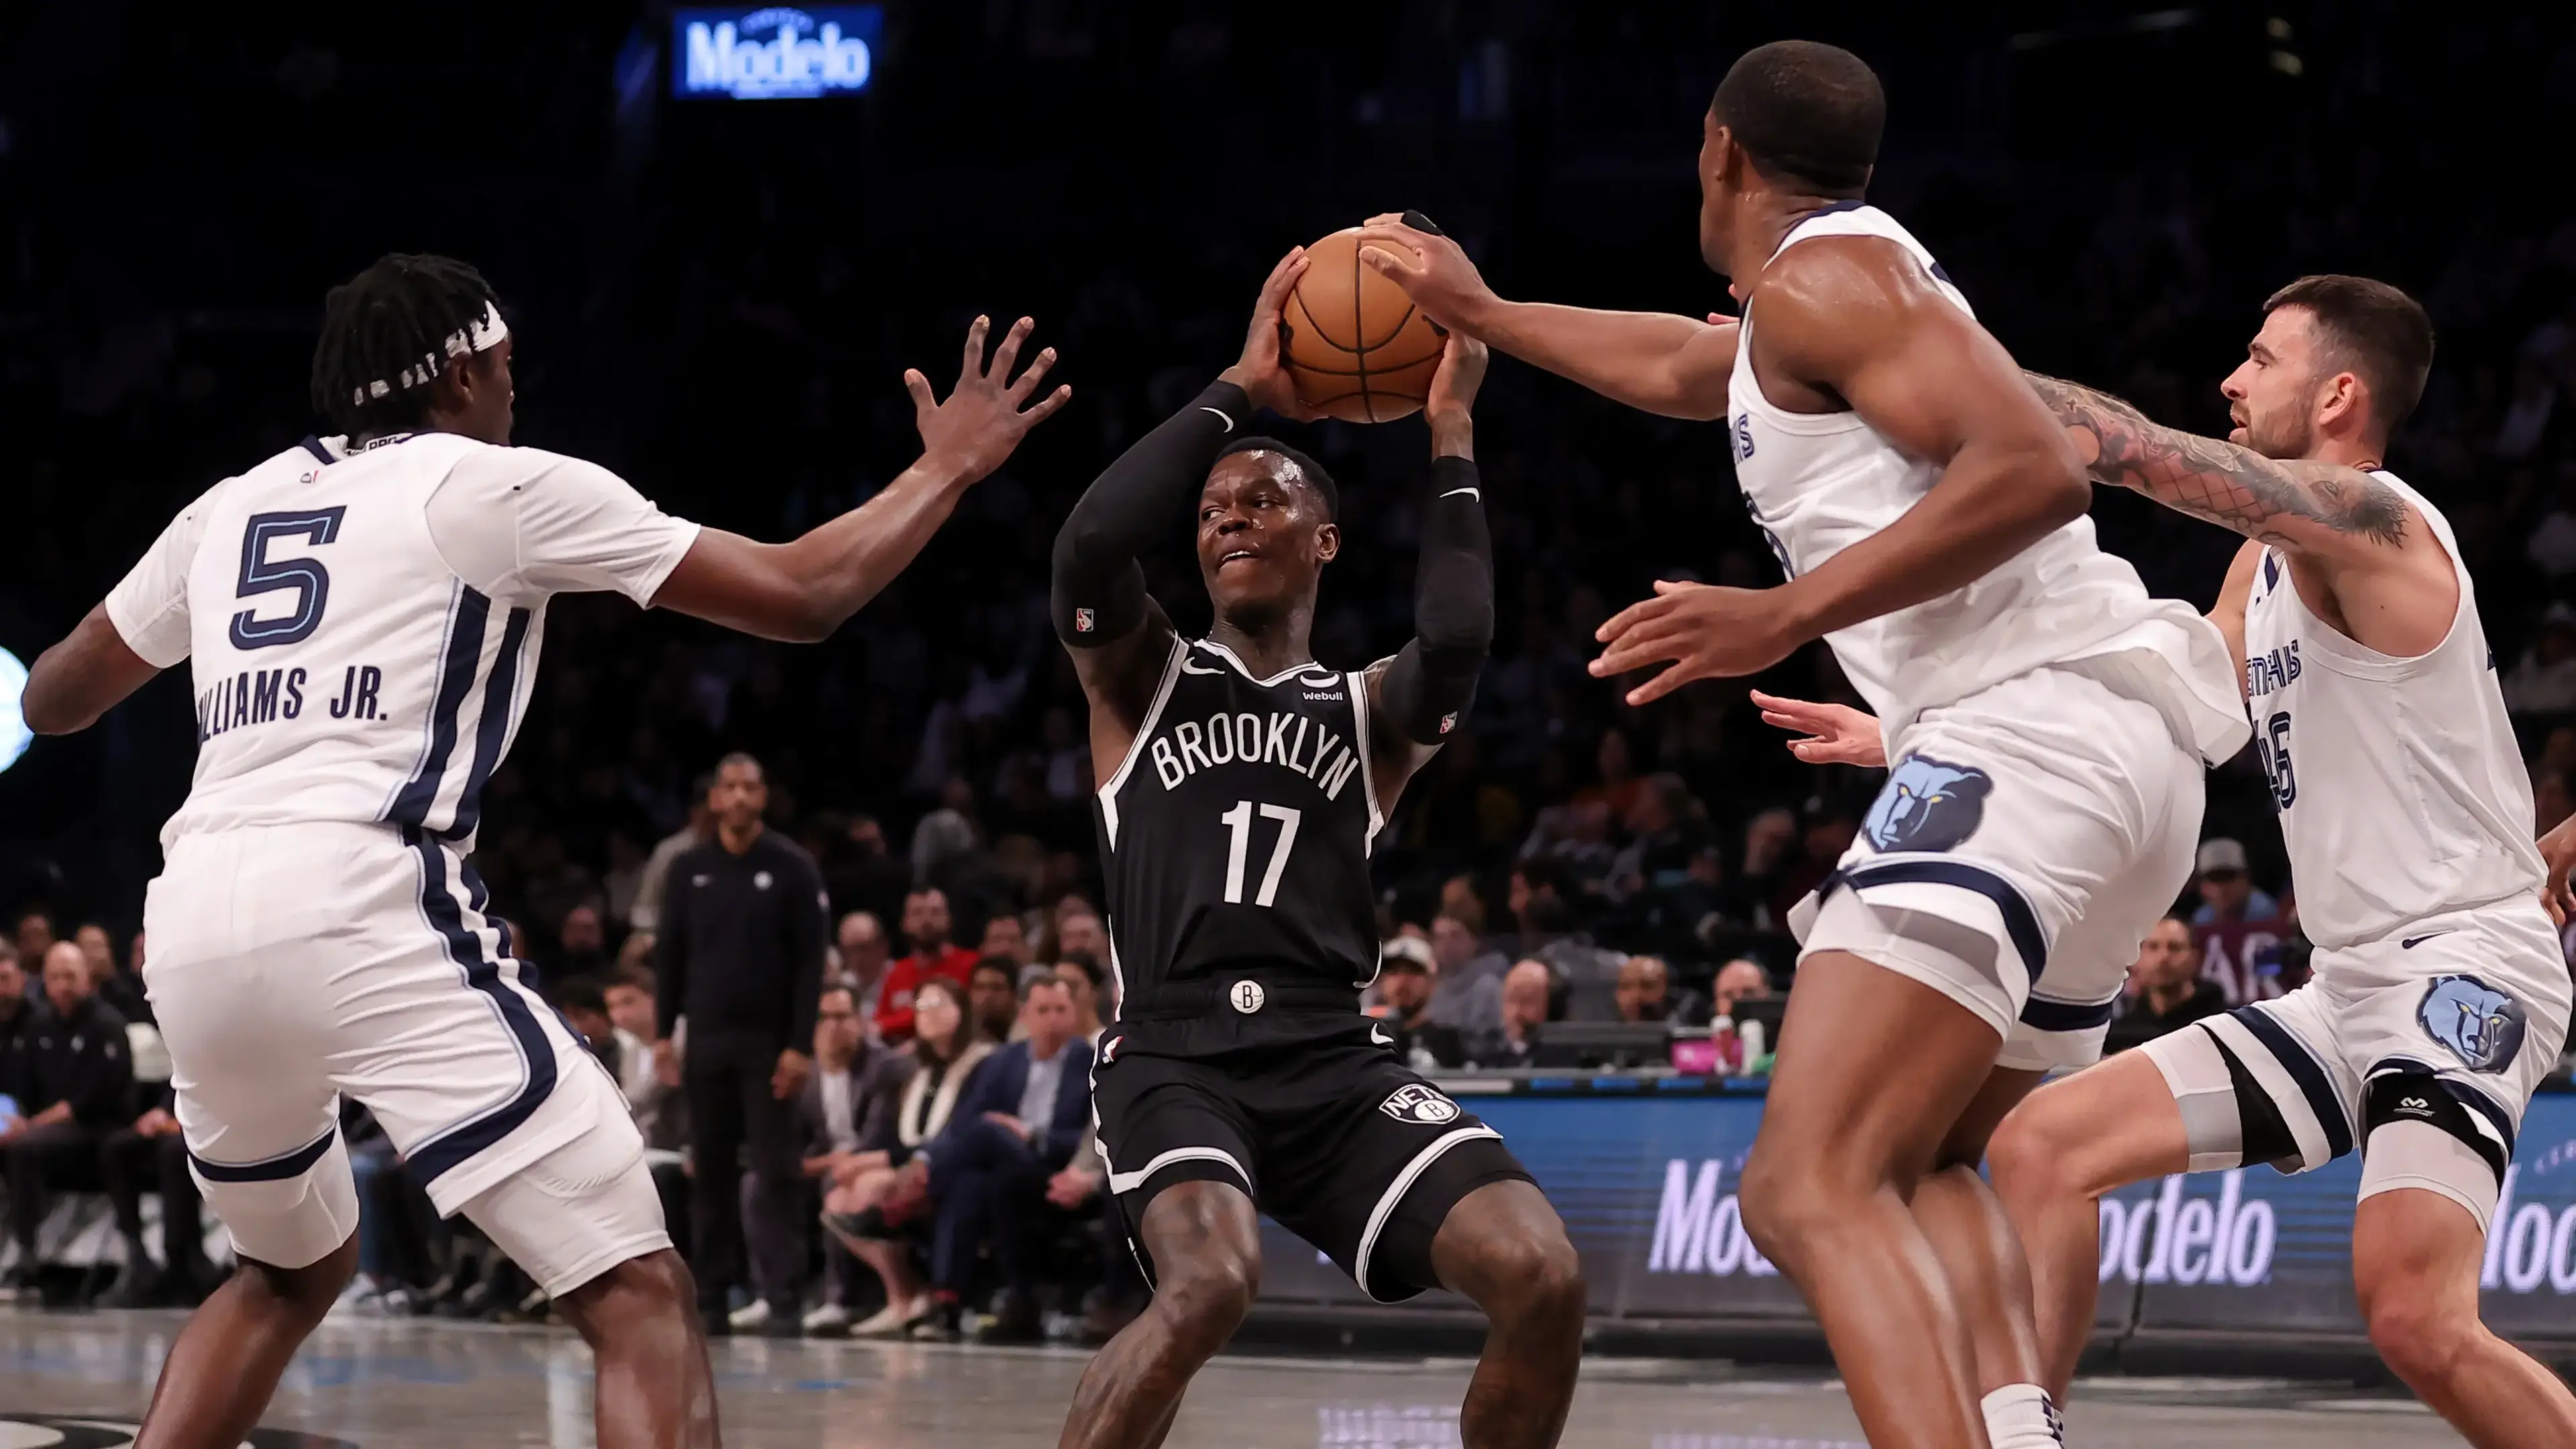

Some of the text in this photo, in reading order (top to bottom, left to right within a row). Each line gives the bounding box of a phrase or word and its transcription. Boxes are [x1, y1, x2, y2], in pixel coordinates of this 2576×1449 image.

[687, 21, 869, 90] Modelo
[229, 505, 347, 650] 5
[199, 665, 387, 743] ILLIAMS JR.
[1302, 692, 1343, 700] Webull
[1151, 712, 1358, 801] BROOKLYN
[1222, 800, 1301, 907] 17
